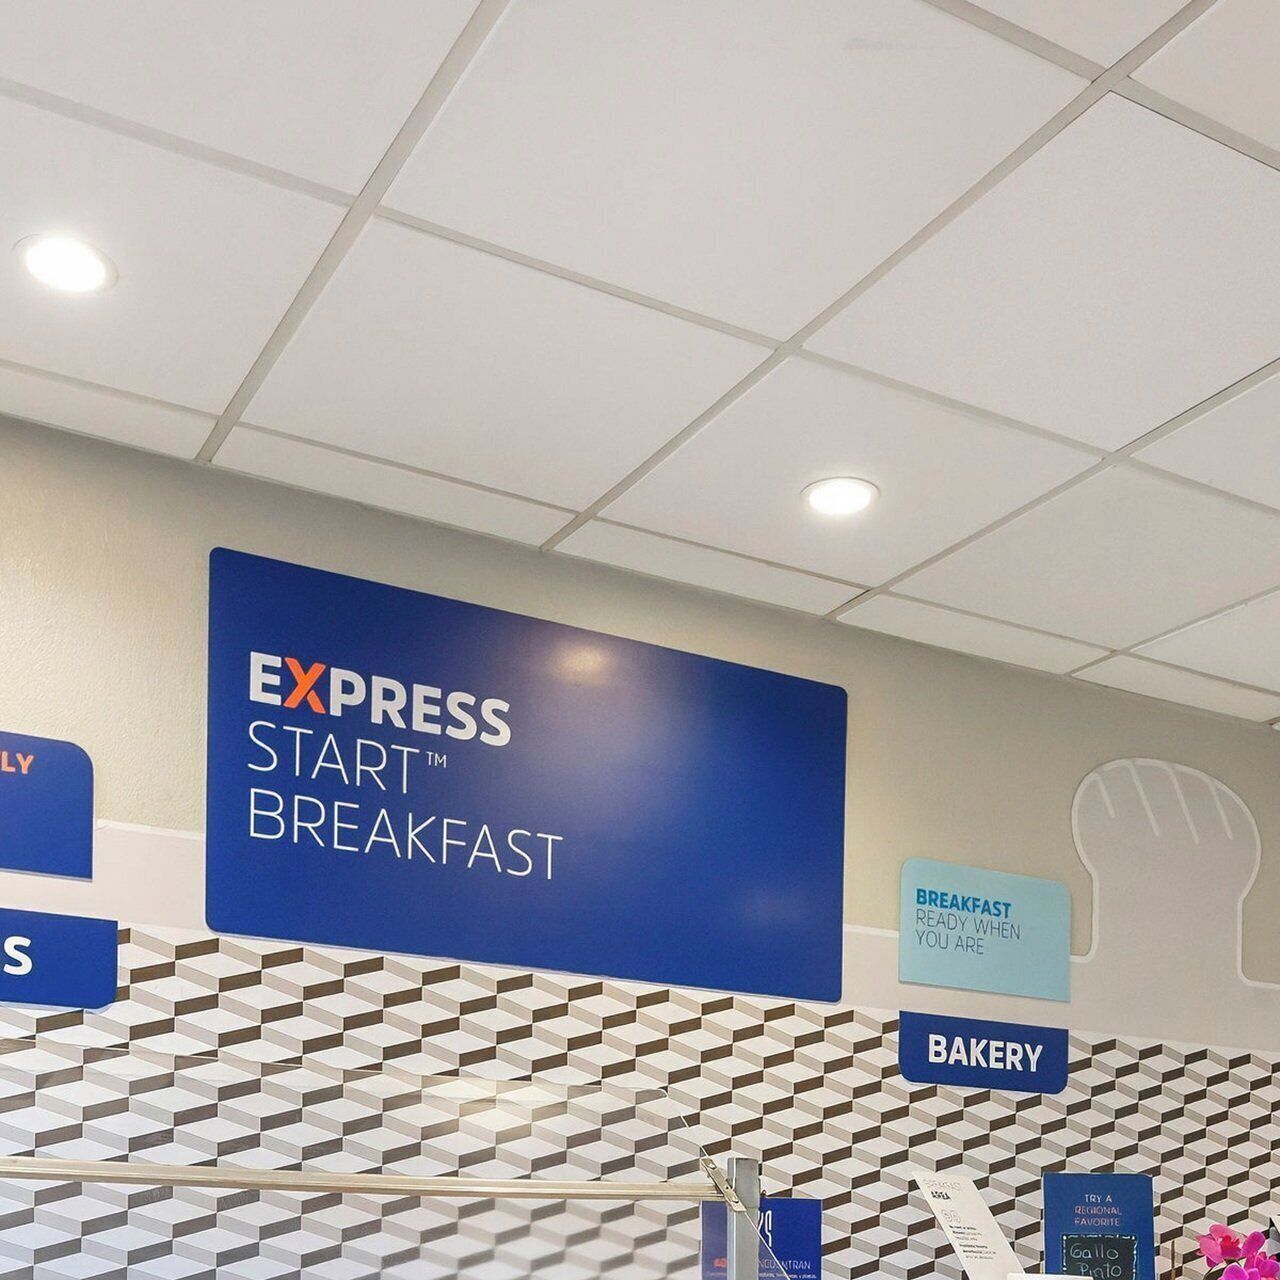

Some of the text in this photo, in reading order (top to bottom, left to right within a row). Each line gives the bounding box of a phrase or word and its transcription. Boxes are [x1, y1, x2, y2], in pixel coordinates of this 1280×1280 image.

[249, 650, 512, 747] EXPRESS
[249, 787, 564, 880] BREAKFAST
[916, 888, 1012, 919] BREAKFAST
[915, 908, 1021, 940] READY WHEN
[915, 929, 985, 955] YOU ARE
[927, 1032, 1044, 1073] BAKERY
[1073, 1204, 1123, 1217] REGIONAL
[1084, 1193, 1114, 1204] TRY A
[1073, 1216, 1122, 1228] FAVORITE
[1068, 1241, 1120, 1261] Gallo
